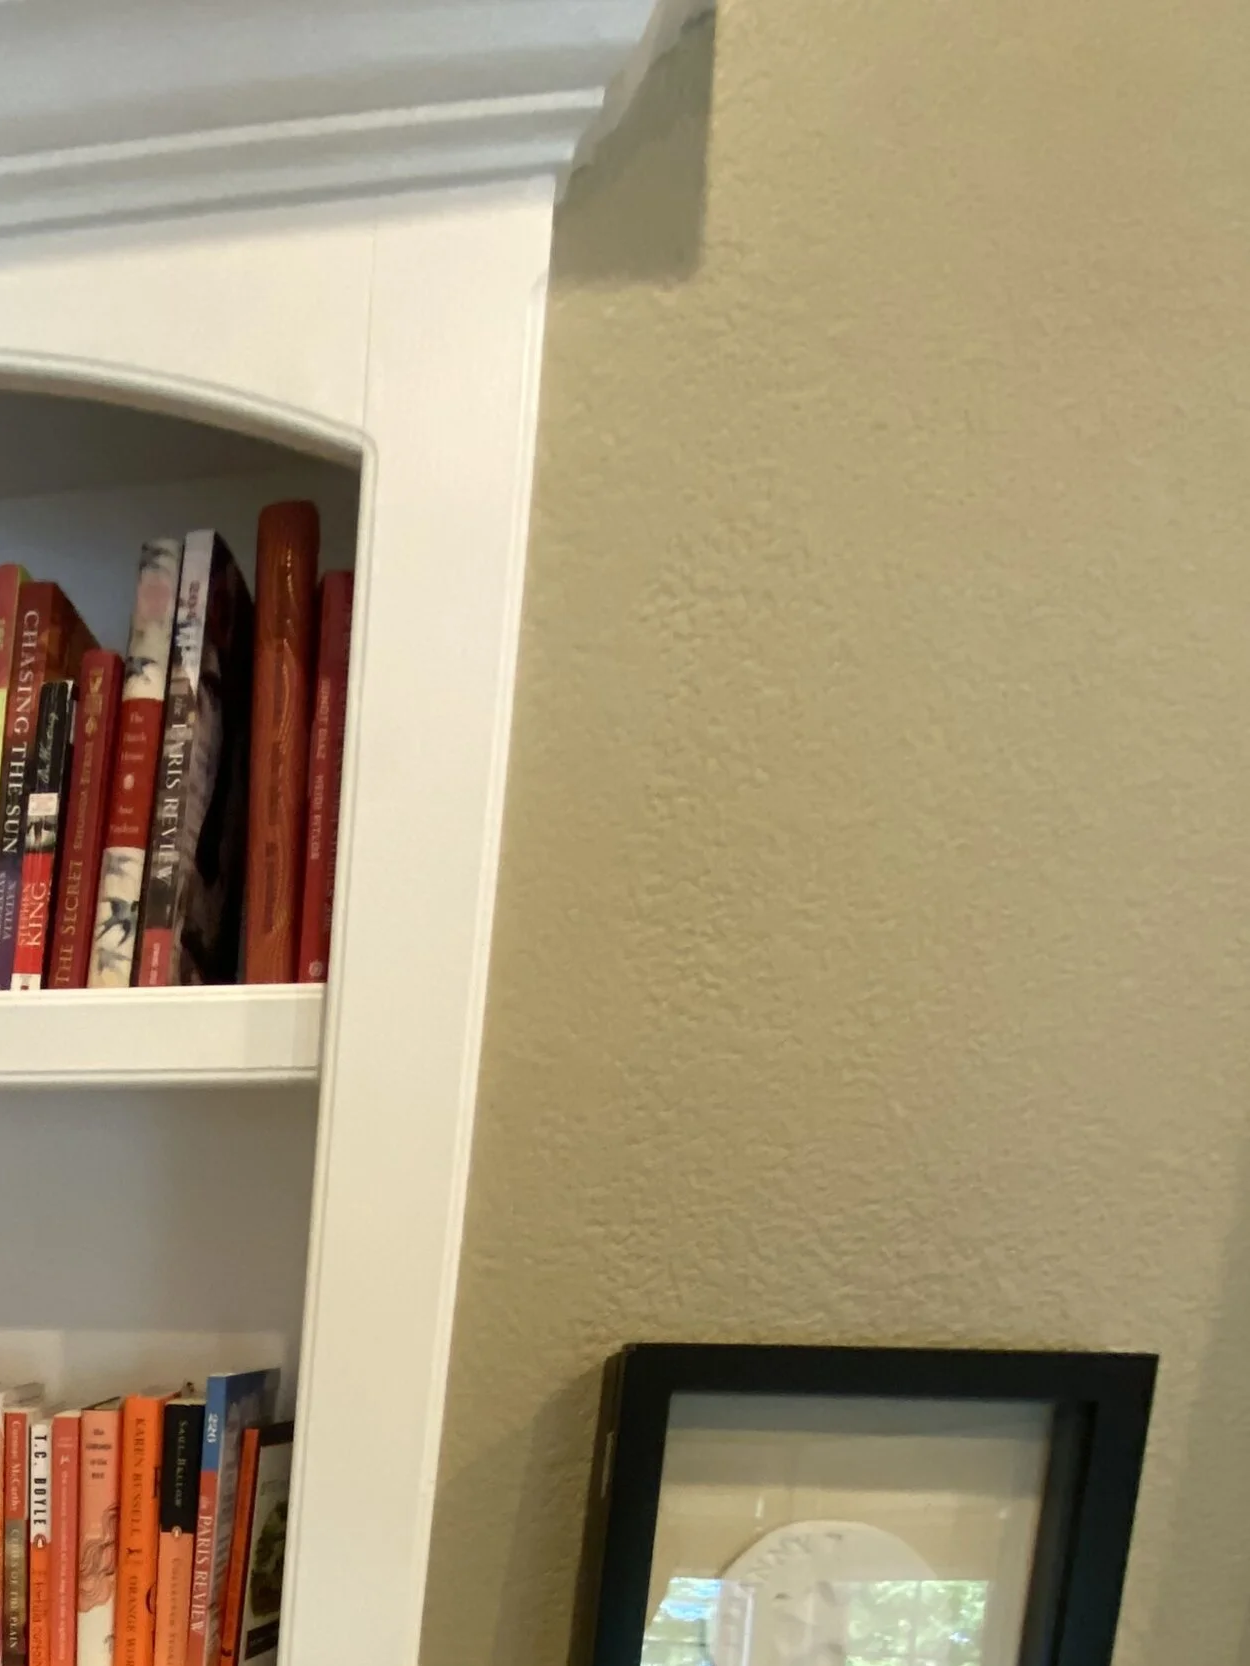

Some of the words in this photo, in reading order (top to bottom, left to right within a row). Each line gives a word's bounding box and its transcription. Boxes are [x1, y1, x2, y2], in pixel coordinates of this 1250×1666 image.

[13, 609, 40, 735] CHASING
[7, 742, 27, 797] THE
[2, 803, 22, 854] SUN
[156, 798, 179, 886] REVIEW
[2, 879, 18, 941] NATALIA
[26, 880, 46, 947] KING
[62, 859, 84, 937] SECRET
[54, 943, 74, 986] THE
[33, 1434, 48, 1467] T.C.
[132, 1417, 147, 1467] KAREN
[33, 1477, 48, 1526] BOYLE
[130, 1472, 144, 1537] RUSSELL
[194, 1514, 214, 1564] PARIS
[126, 1574, 139, 1633] ORANGE
[190, 1569, 209, 1633] REVIEW
[8, 1616, 20, 1650] PLAIN
